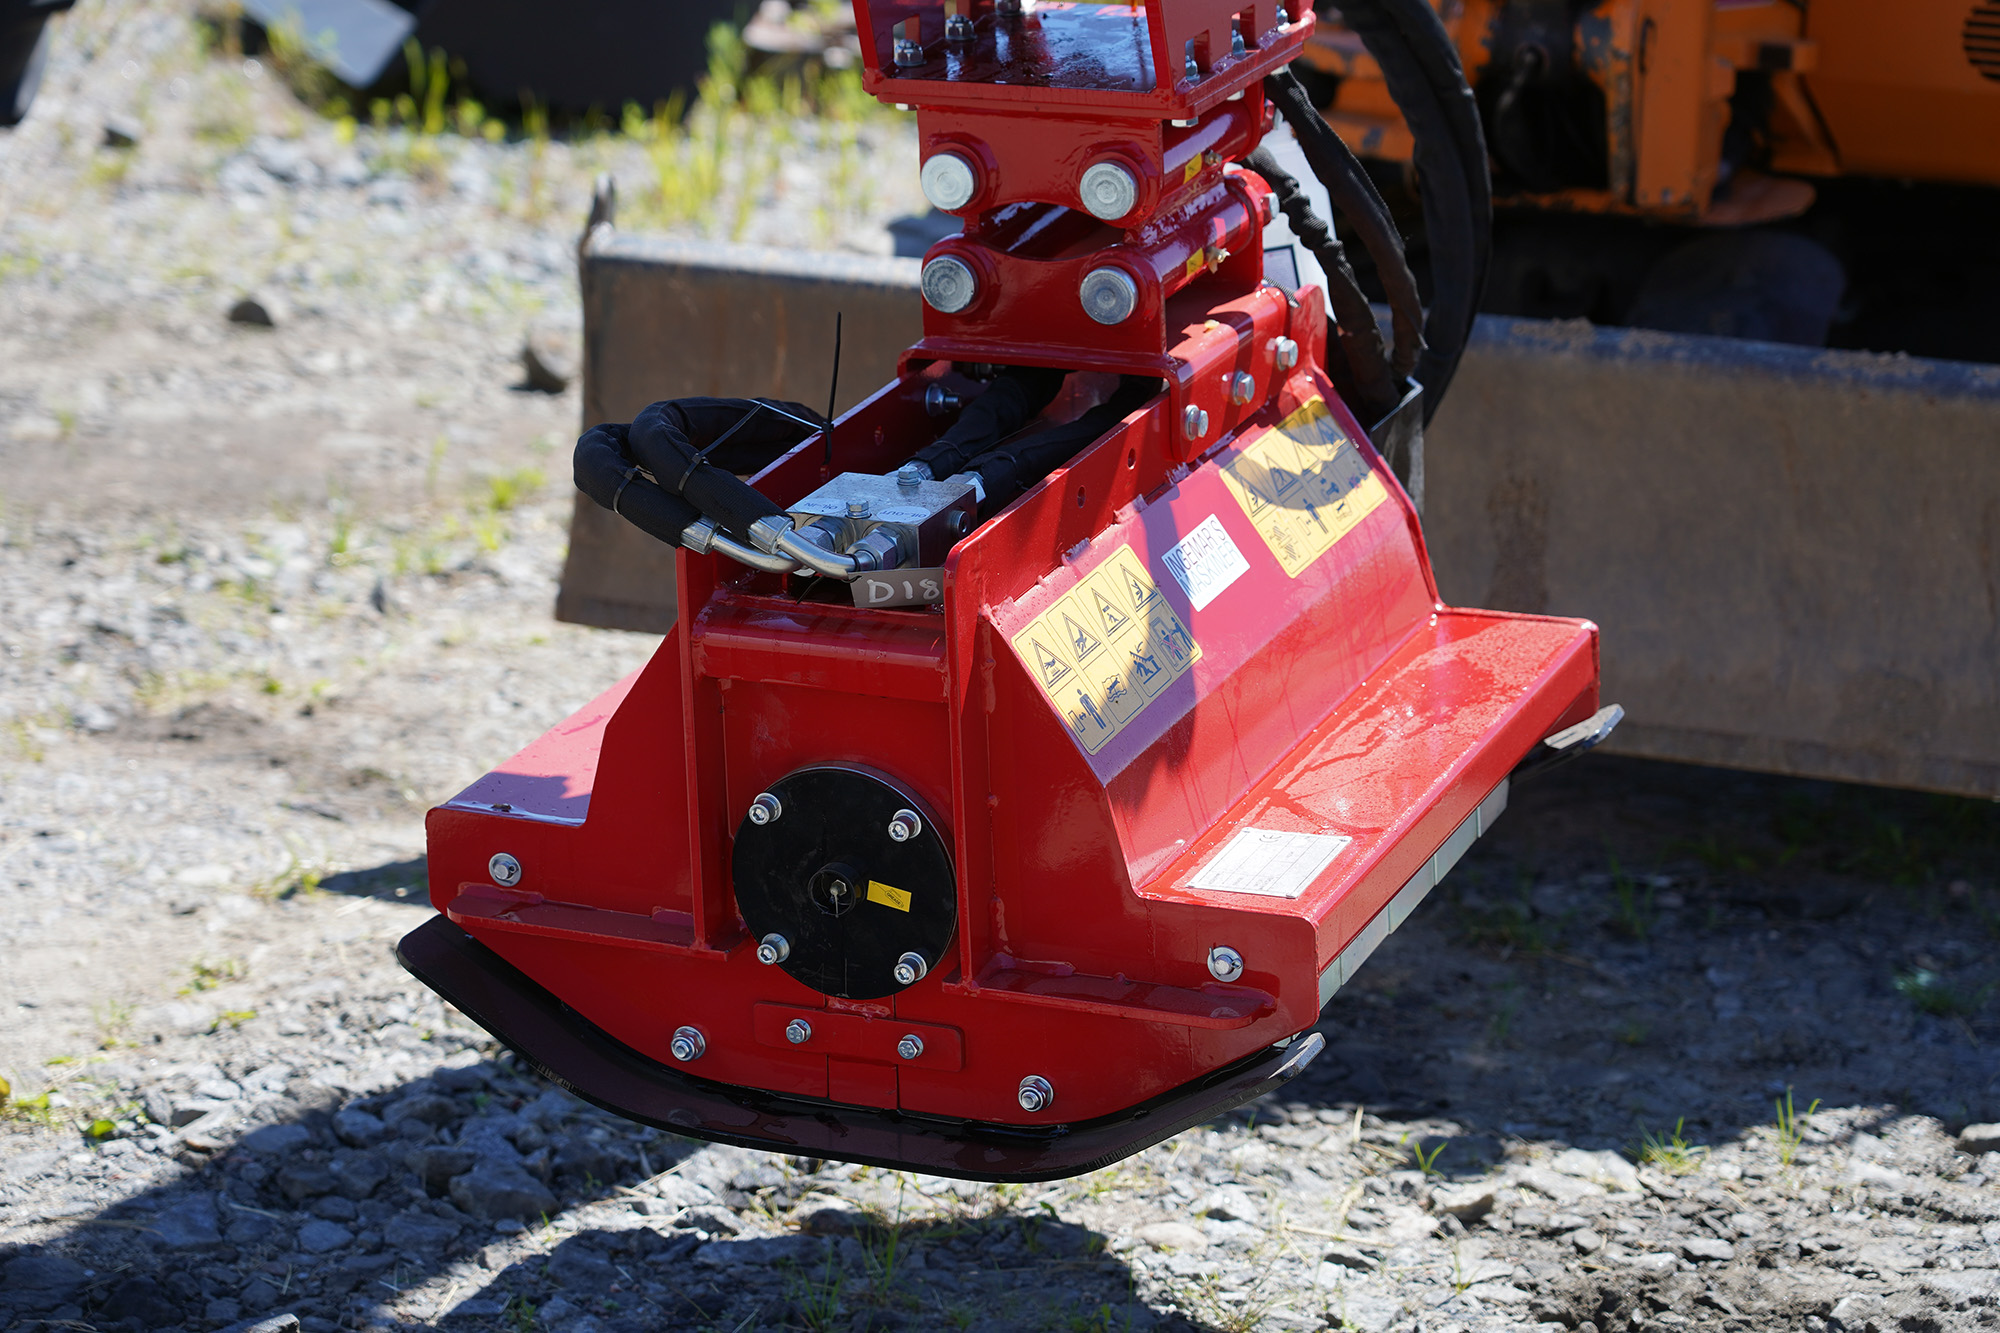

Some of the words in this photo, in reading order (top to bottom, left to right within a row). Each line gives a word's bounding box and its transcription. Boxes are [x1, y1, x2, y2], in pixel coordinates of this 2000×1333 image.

[1164, 519, 1226, 579] INGEMAR'S
[1179, 540, 1241, 599] MASKINER
[867, 578, 940, 603] D18
